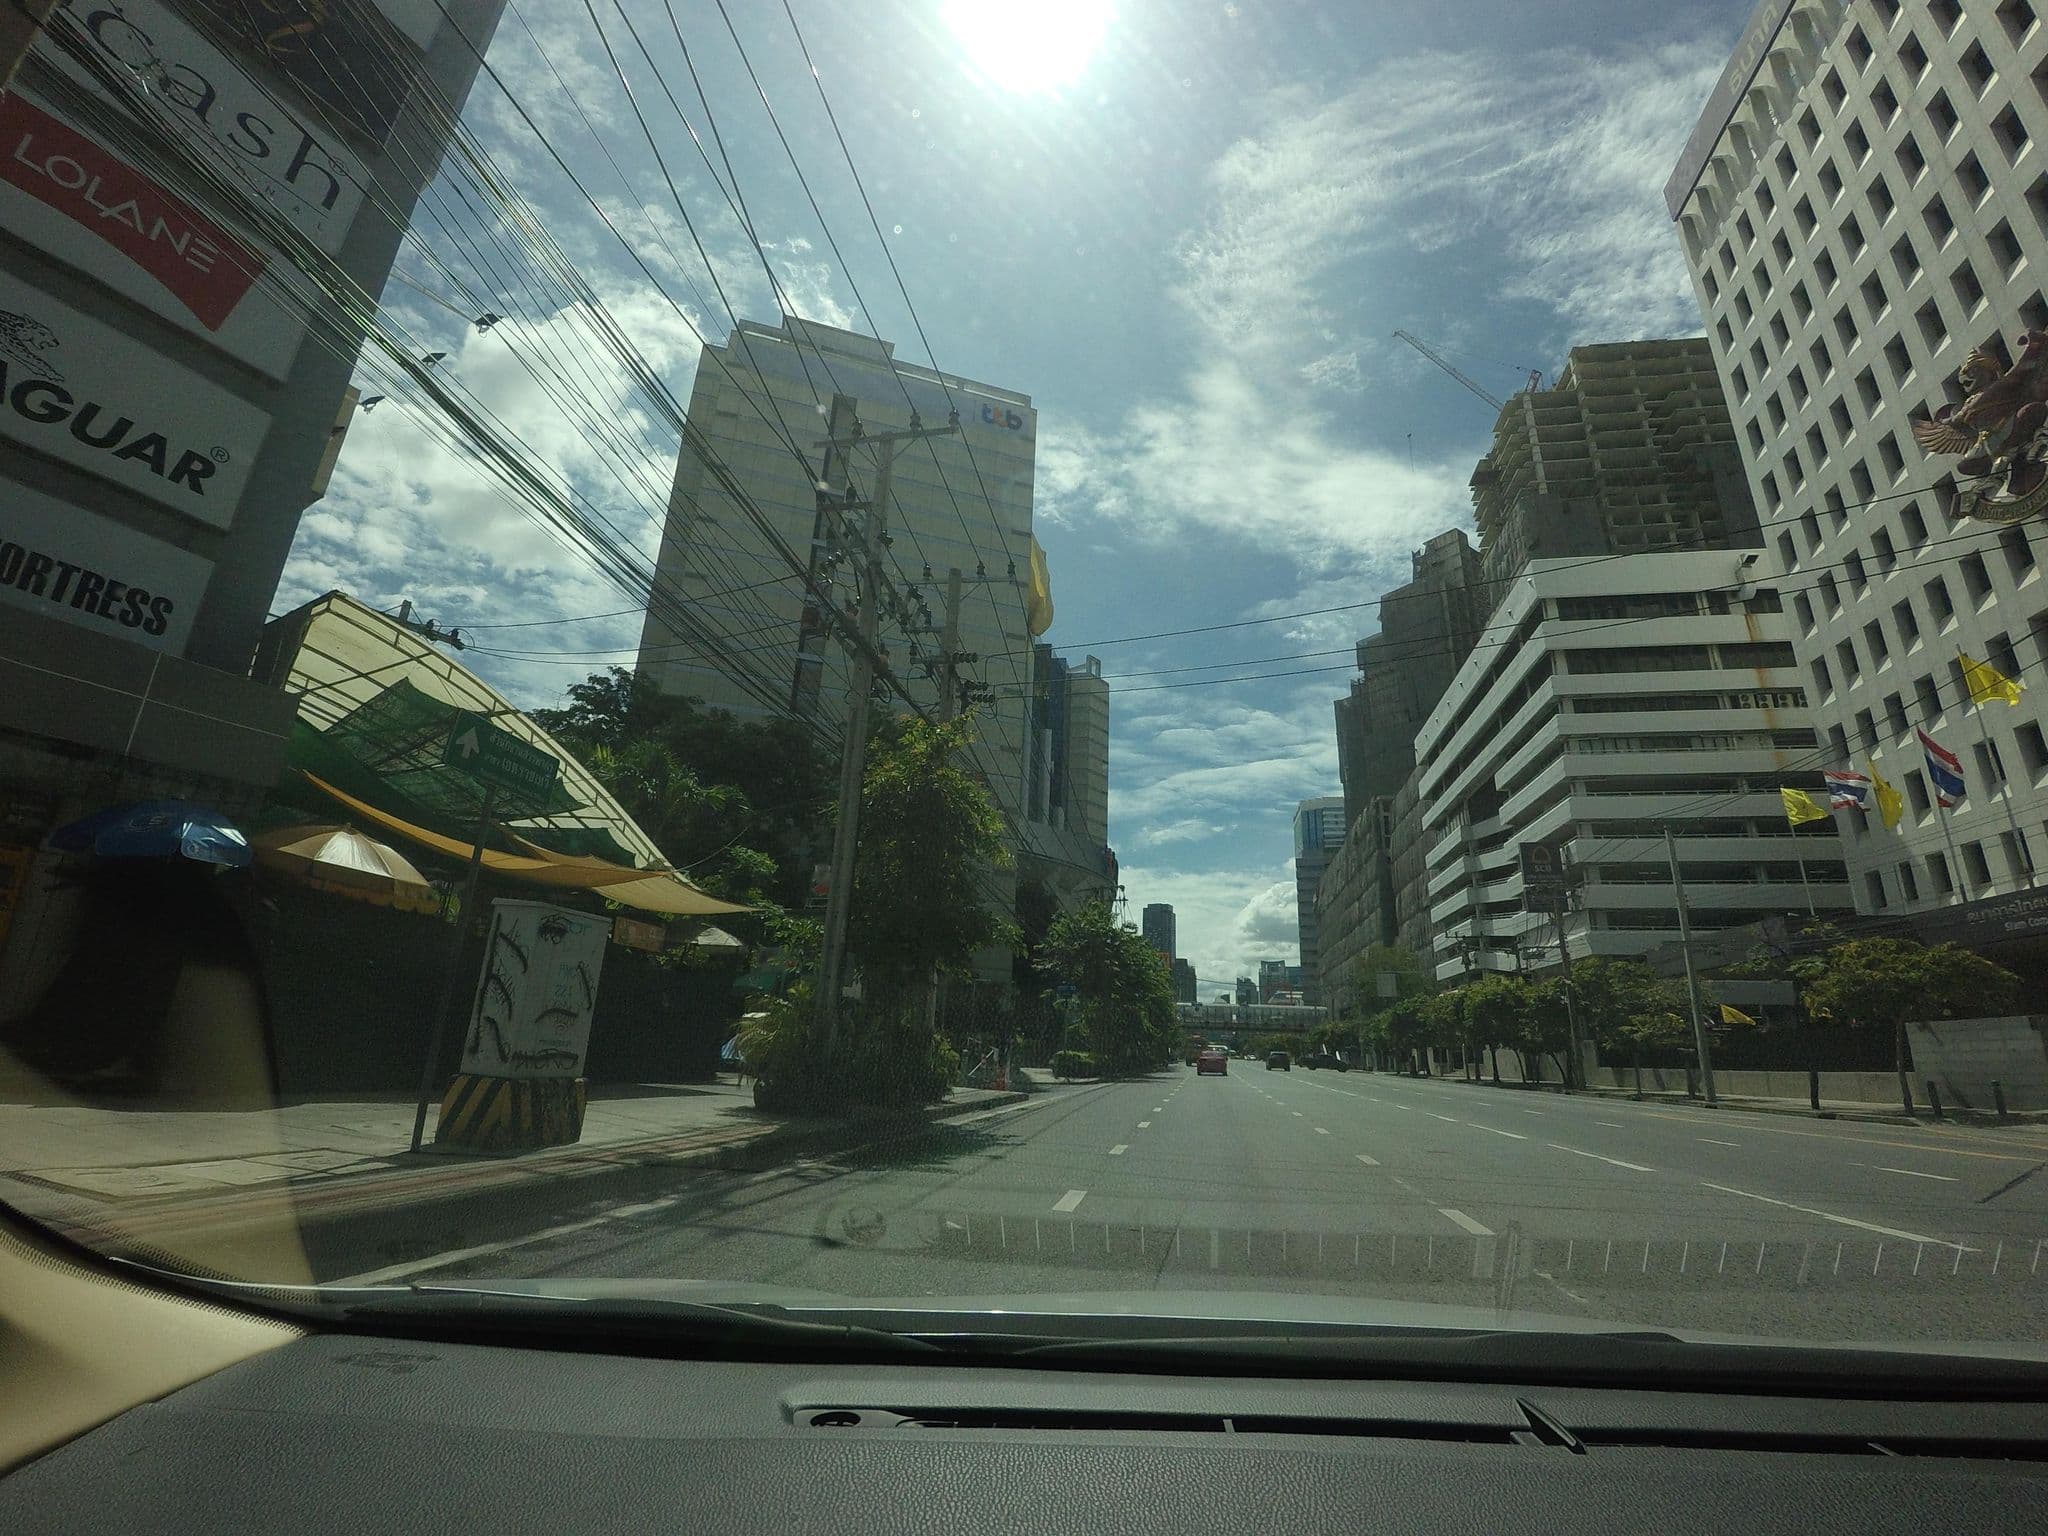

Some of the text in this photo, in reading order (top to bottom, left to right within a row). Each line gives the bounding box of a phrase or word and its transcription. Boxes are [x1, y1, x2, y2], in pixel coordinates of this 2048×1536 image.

[14, 134, 219, 273] LOLANE
[0, 359, 217, 496] GUAR
[0, 538, 174, 636] ORTRESS
